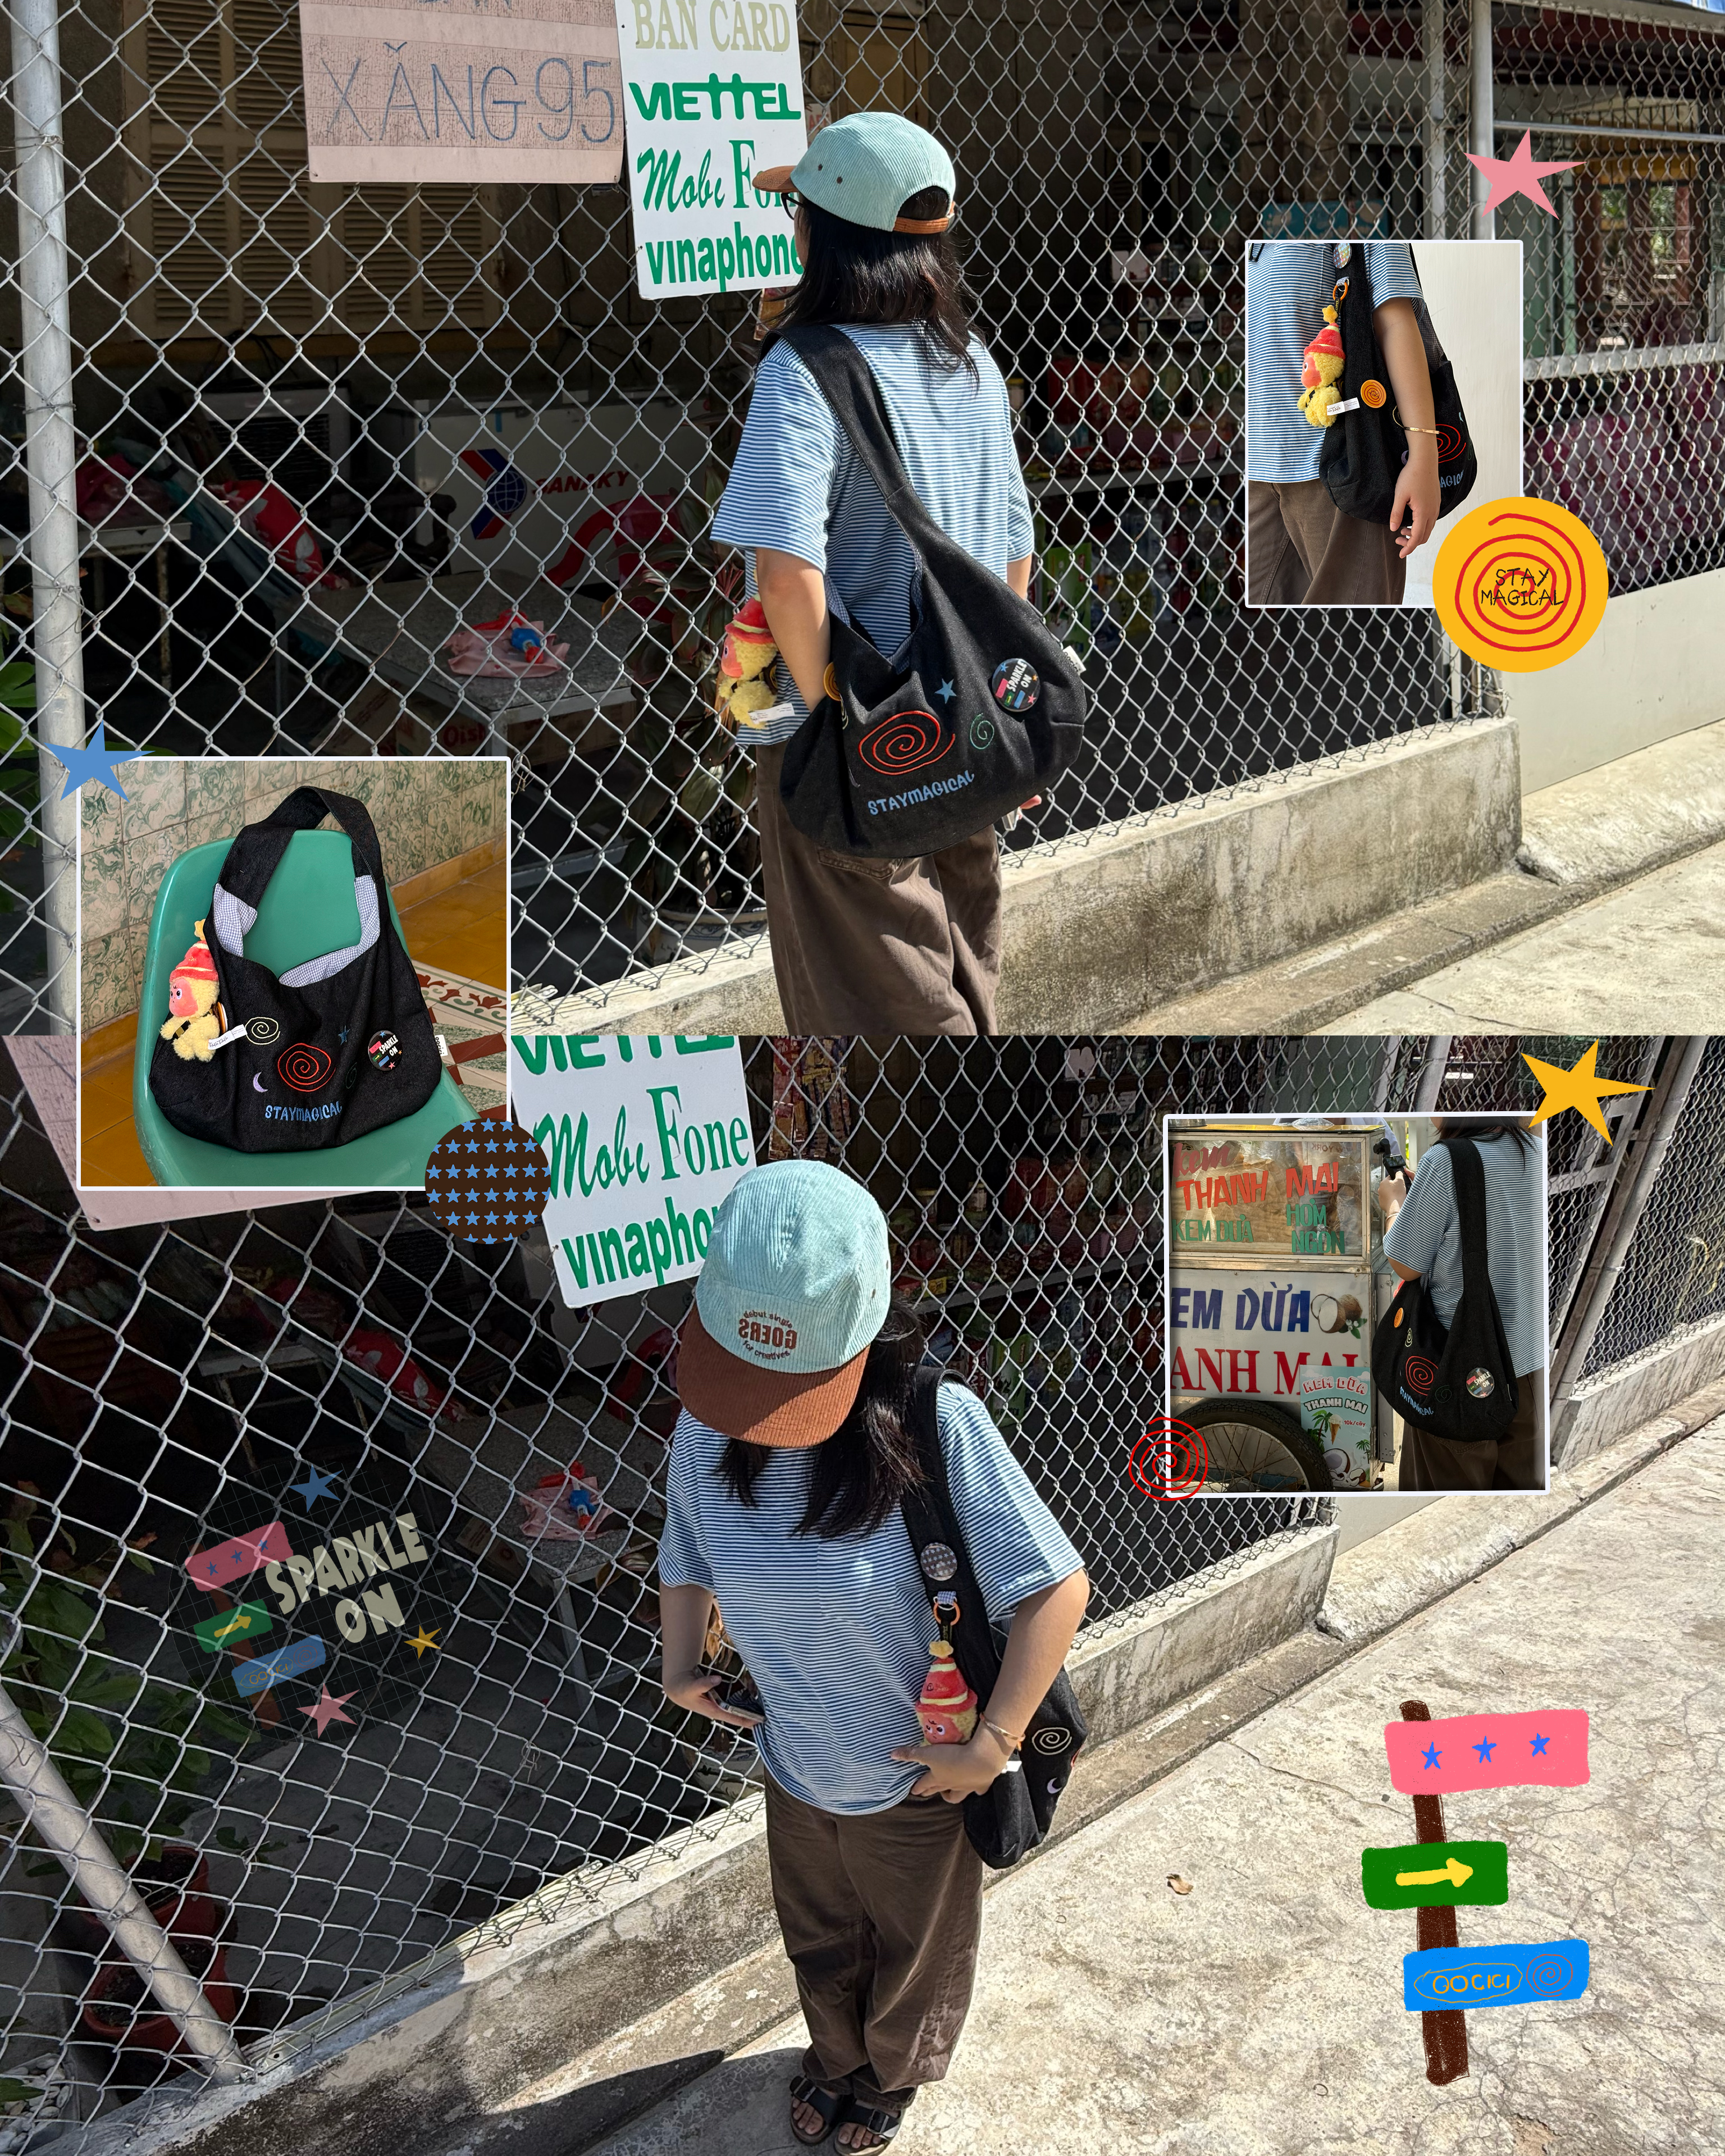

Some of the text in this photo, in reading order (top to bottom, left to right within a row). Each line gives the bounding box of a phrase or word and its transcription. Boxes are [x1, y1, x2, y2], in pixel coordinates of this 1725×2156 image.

[710, 0, 790, 52] CARD
[536, 58, 615, 143] 95
[628, 73, 801, 121] VIETTEL
[532, 471, 629, 495] SANAKY
[1007, 659, 1027, 692] SPARKLE
[1021, 674, 1032, 688] ON
[868, 770, 974, 815] STAYMAGICAL
[379, 1034, 398, 1054] SPARKLE
[389, 1046, 398, 1056] ON
[265, 1101, 342, 1122] STAYMAGICAL
[646, 1085, 749, 1180] Fone
[1175, 1162, 1339, 1211] THANH MAI
[1172, 1219, 1211, 1241] KEM
[1292, 1230, 1345, 1254] NGON
[561, 1196, 719, 1289] vinapho
[743, 1310, 767, 1318] debut
[1170, 1281, 1311, 1332] EM DỪA
[1170, 1346, 1261, 1394] ANH
[1474, 1371, 1491, 1386] SPARKLE
[1303, 1376, 1334, 1394] KEM
[1304, 1397, 1368, 1414] THANH MAI
